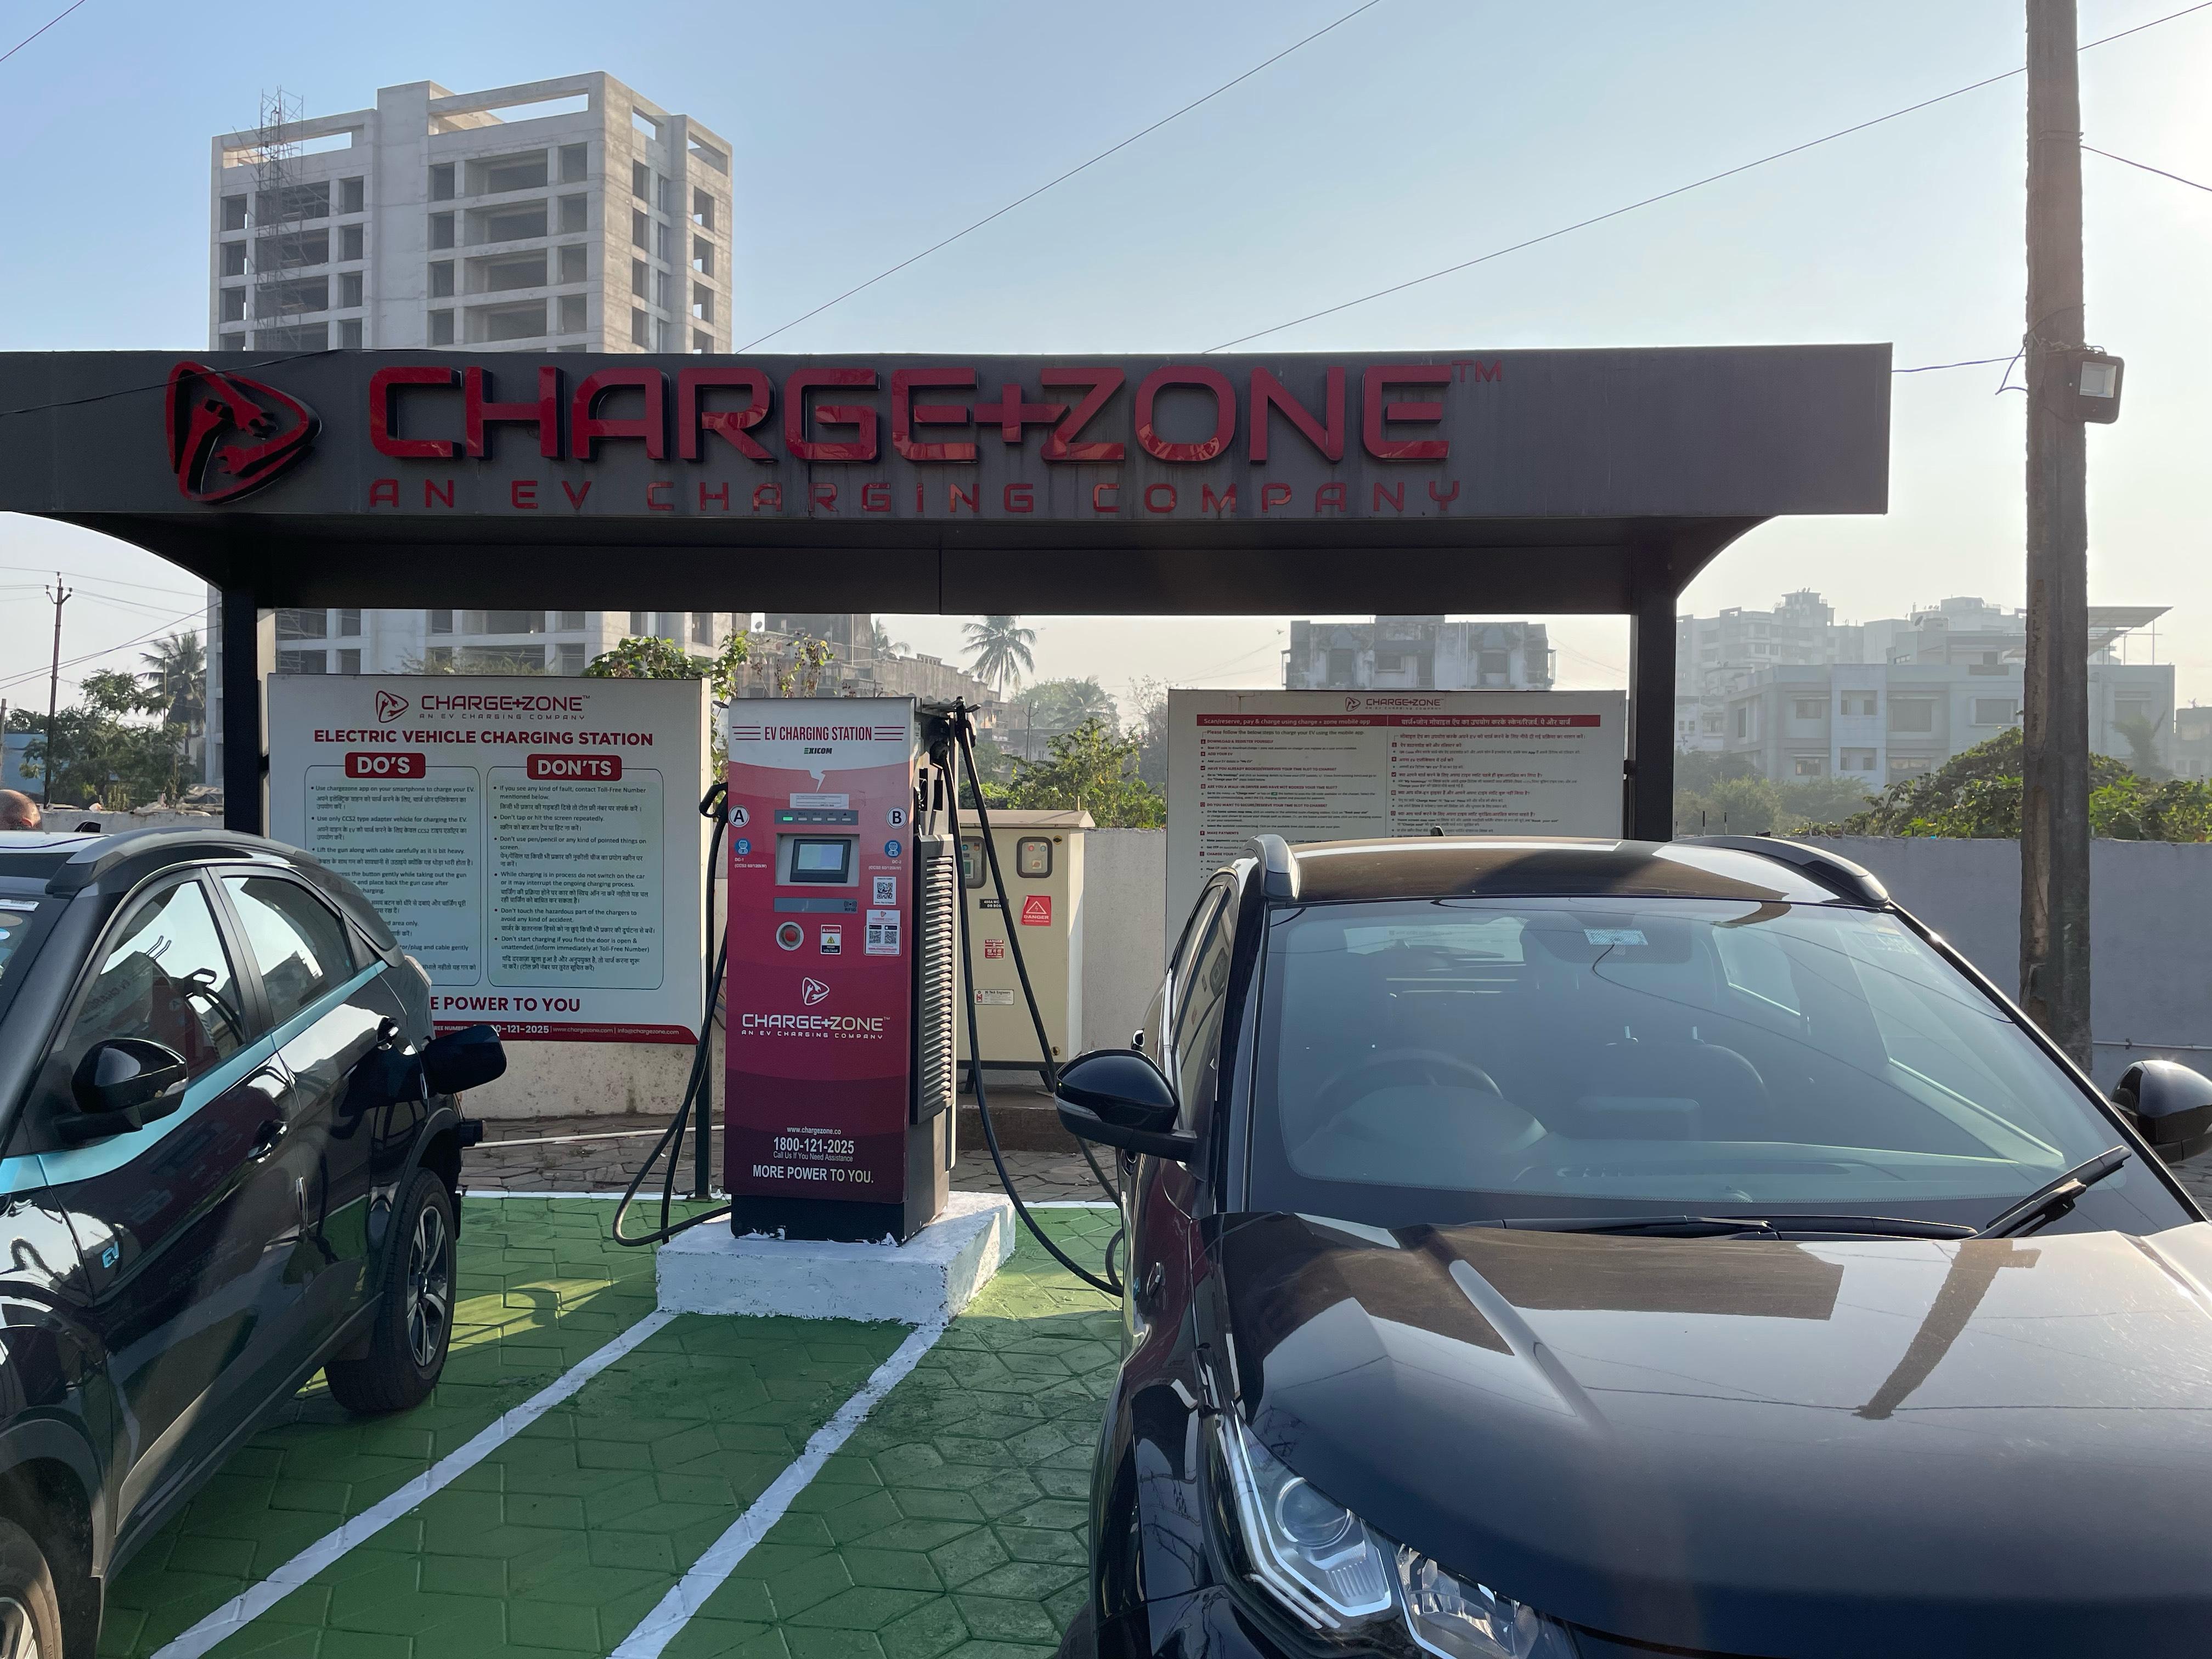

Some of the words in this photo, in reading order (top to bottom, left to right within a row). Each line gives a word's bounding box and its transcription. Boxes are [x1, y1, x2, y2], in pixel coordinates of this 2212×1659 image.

[369, 365, 1451, 463] CHARGE+ZONE
[370, 478, 455, 509] AN
[511, 479, 591, 510] EV
[647, 481, 1034, 512] CHARGING
[1092, 481, 1460, 514] COMPANY
[421, 695, 583, 712] CHARGE+ZONE
[314, 730, 397, 742] ELECTRIC
[402, 730, 476, 743] VEHICLE
[481, 731, 574, 744] CHARGING
[579, 732, 653, 746] STATION
[764, 726, 777, 741] EV
[780, 726, 829, 741] CHARGING
[832, 726, 872, 741] STATION
[357, 757, 410, 774] DO'S
[537, 759, 612, 776] DON'TS
[733, 809, 745, 823] A
[892, 811, 902, 824] B
[556, 944, 591, 952] immediately
[444, 996, 509, 1011] POWER
[513, 997, 537, 1012] TO
[541, 998, 580, 1012] YOU
[742, 1013, 883, 1031] CHARGE+ZONE
[787, 1126, 842, 1136] www.chargezone.co
[773, 1137, 855, 1154] 1800-121-2025
[825, 1154, 853, 1163] Assistance
[753, 1164, 785, 1179] MORE
[787, 1166, 827, 1181] POWER
[830, 1169, 845, 1182] TO
[848, 1170, 874, 1184] YOU.
